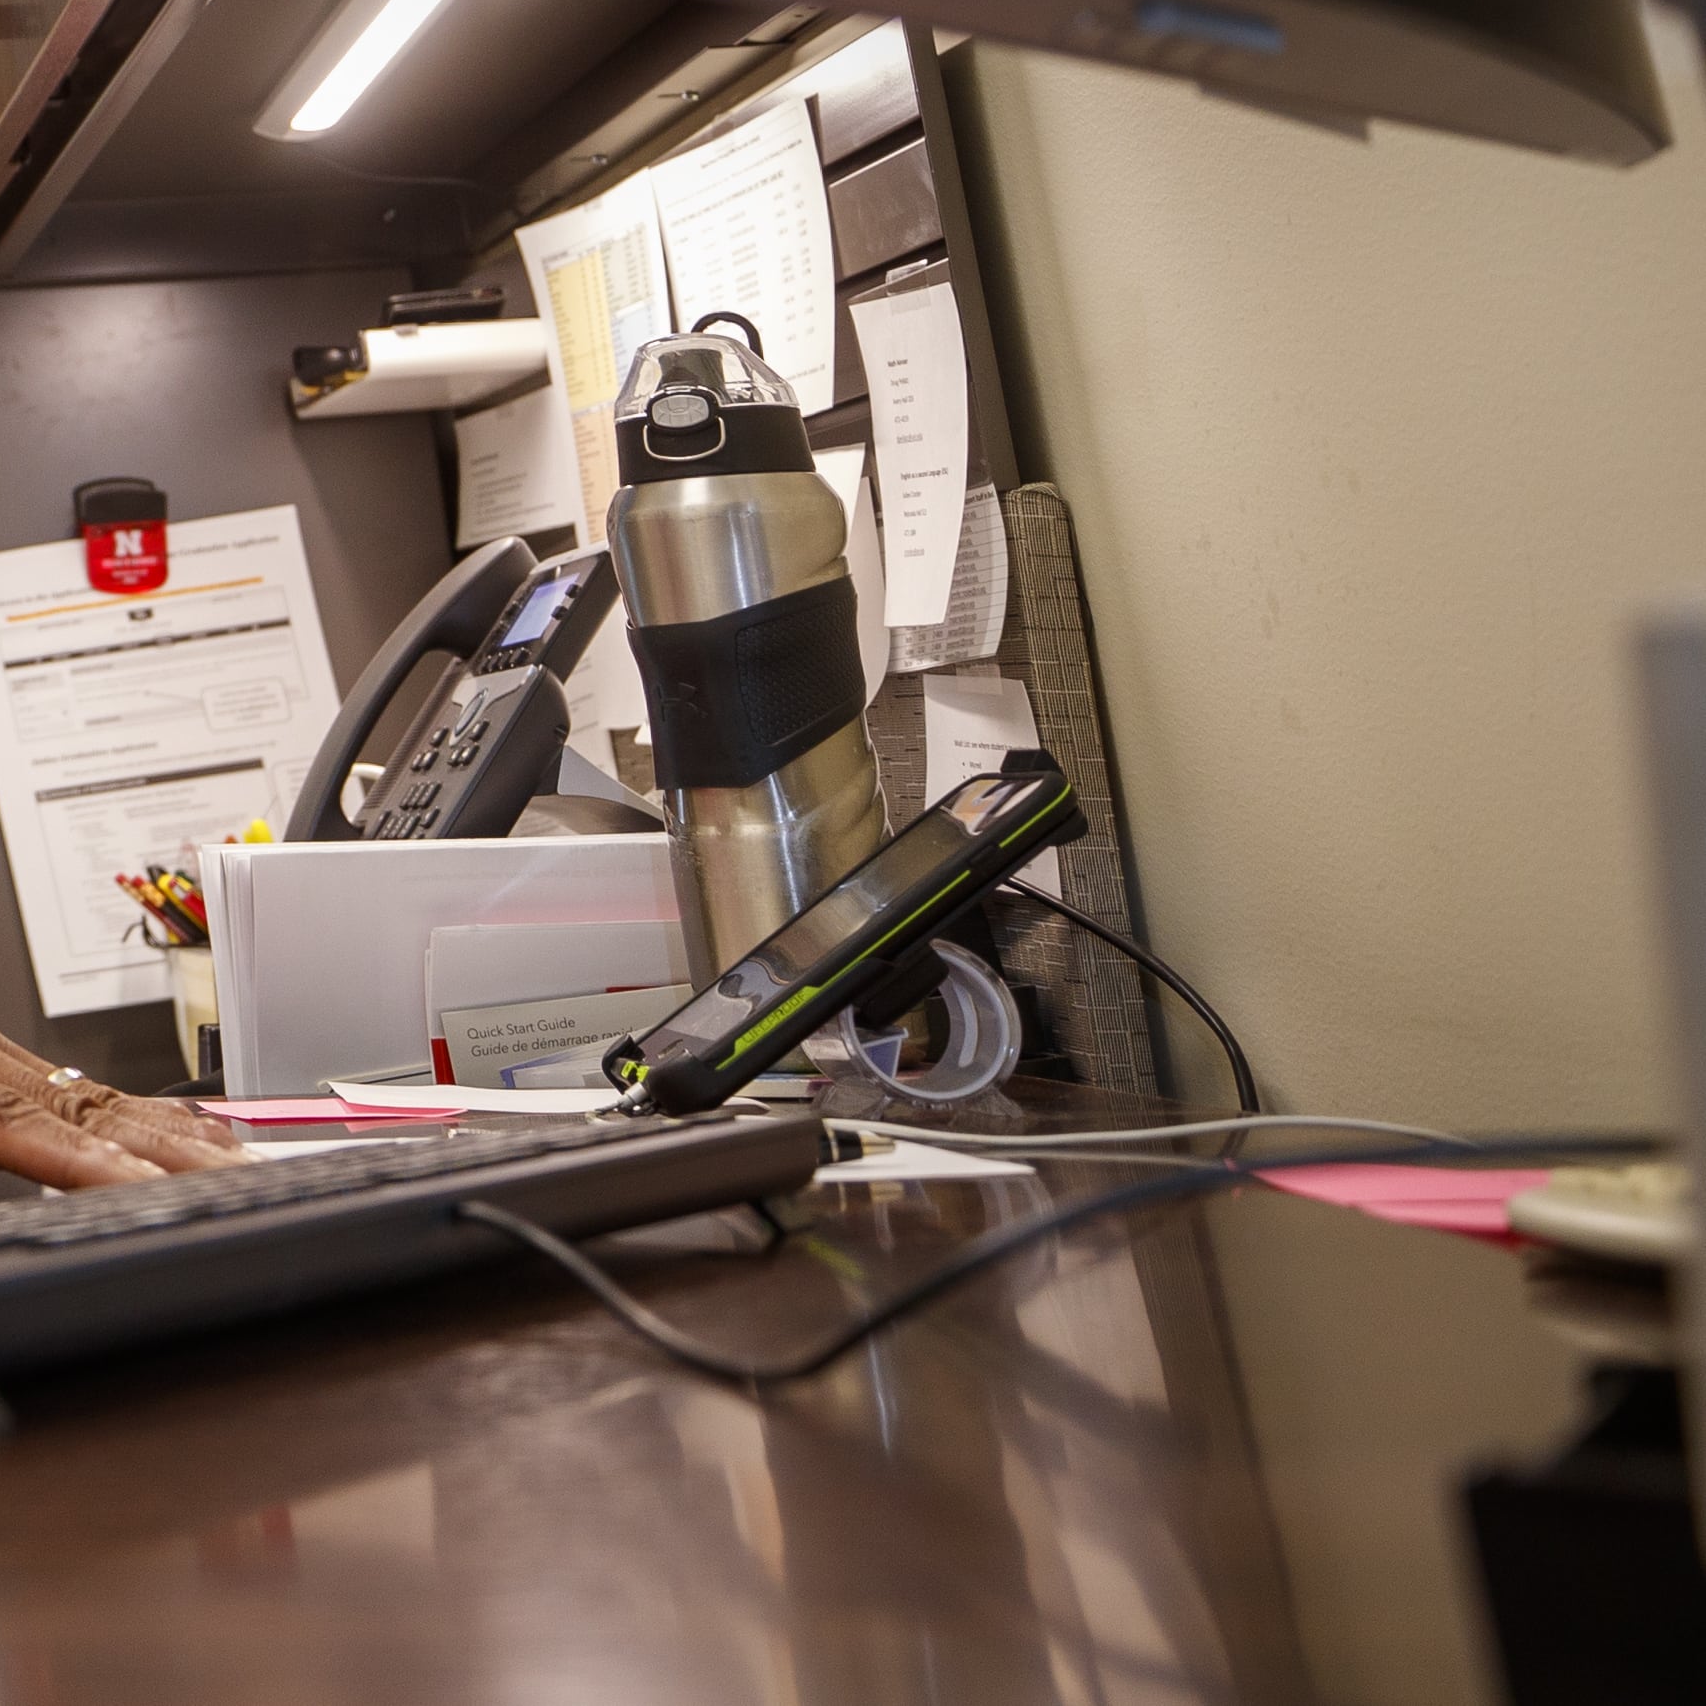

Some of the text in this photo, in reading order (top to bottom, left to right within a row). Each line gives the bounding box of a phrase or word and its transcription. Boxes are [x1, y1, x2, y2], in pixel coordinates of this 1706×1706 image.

[113, 529, 144, 557] N
[467, 1017, 576, 1041] Quick Start Guide
[471, 1027, 634, 1058] Guide de démarrage rapid
